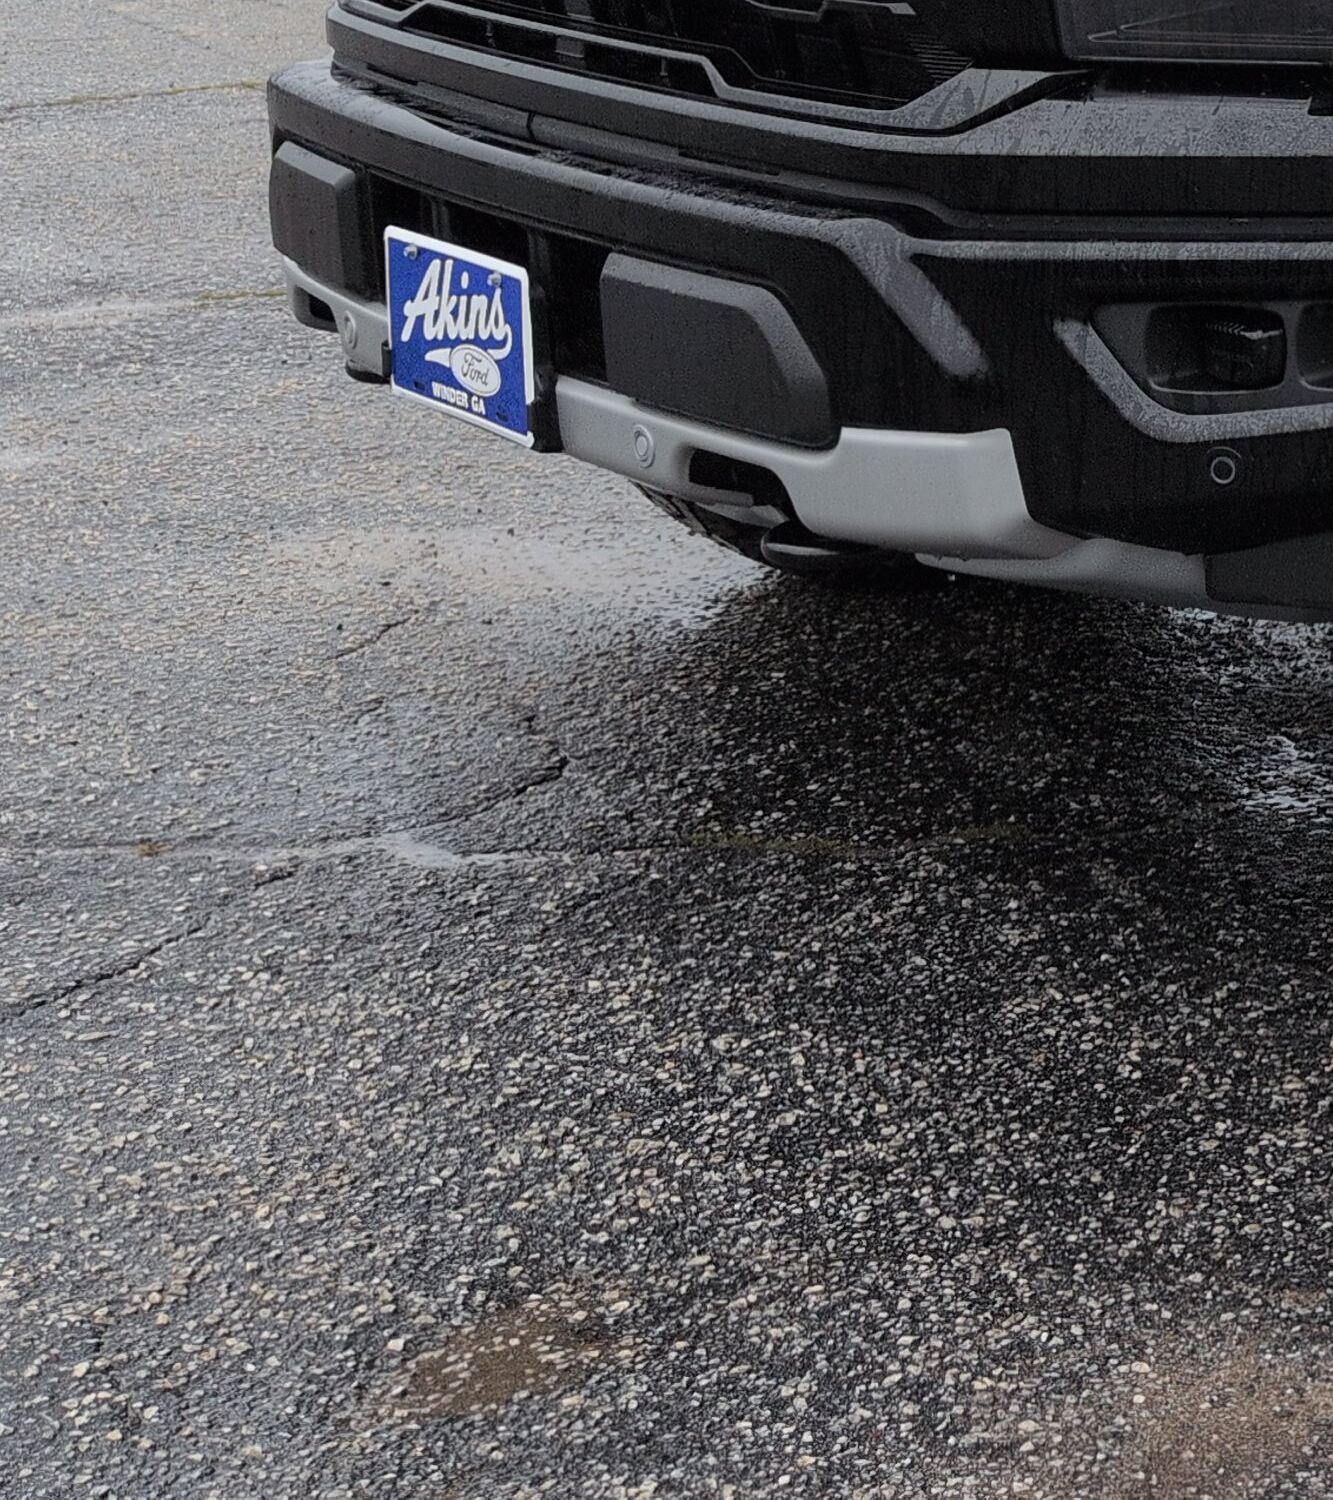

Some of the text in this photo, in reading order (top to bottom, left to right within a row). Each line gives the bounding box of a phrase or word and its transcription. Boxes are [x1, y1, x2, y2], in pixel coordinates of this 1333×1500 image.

[401, 258, 512, 343] Akins
[460, 352, 490, 387] Ford
[431, 381, 486, 416] WINDER GA
